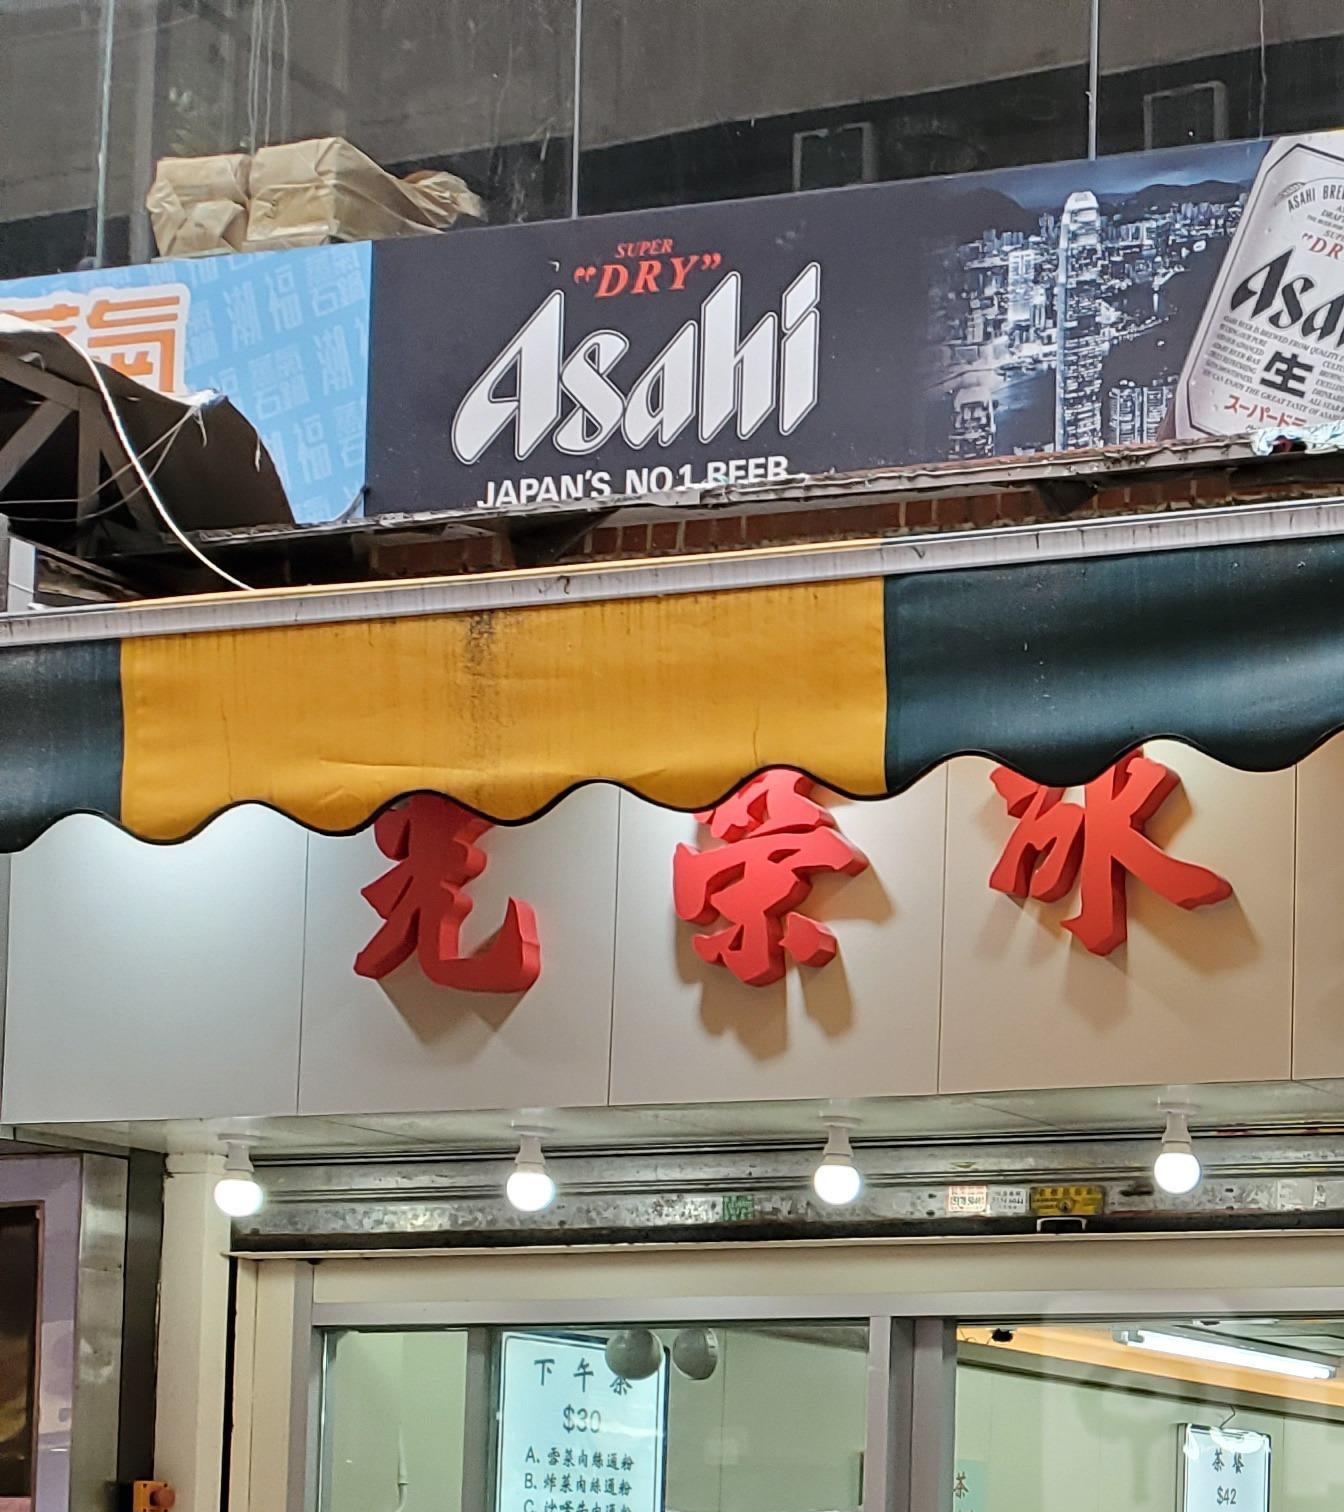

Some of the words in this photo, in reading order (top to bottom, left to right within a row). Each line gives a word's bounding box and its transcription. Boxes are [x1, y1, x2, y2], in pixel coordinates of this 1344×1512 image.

[1287, 188, 1316, 212] ASAHI
[615, 239, 673, 258] SUPER
[451, 261, 821, 466] Asahi
[1259, 351, 1314, 398] 生
[477, 469, 611, 509] JAPAN'S
[562, 1403, 601, 1433] $30
[1216, 1486, 1237, 1505] $42
